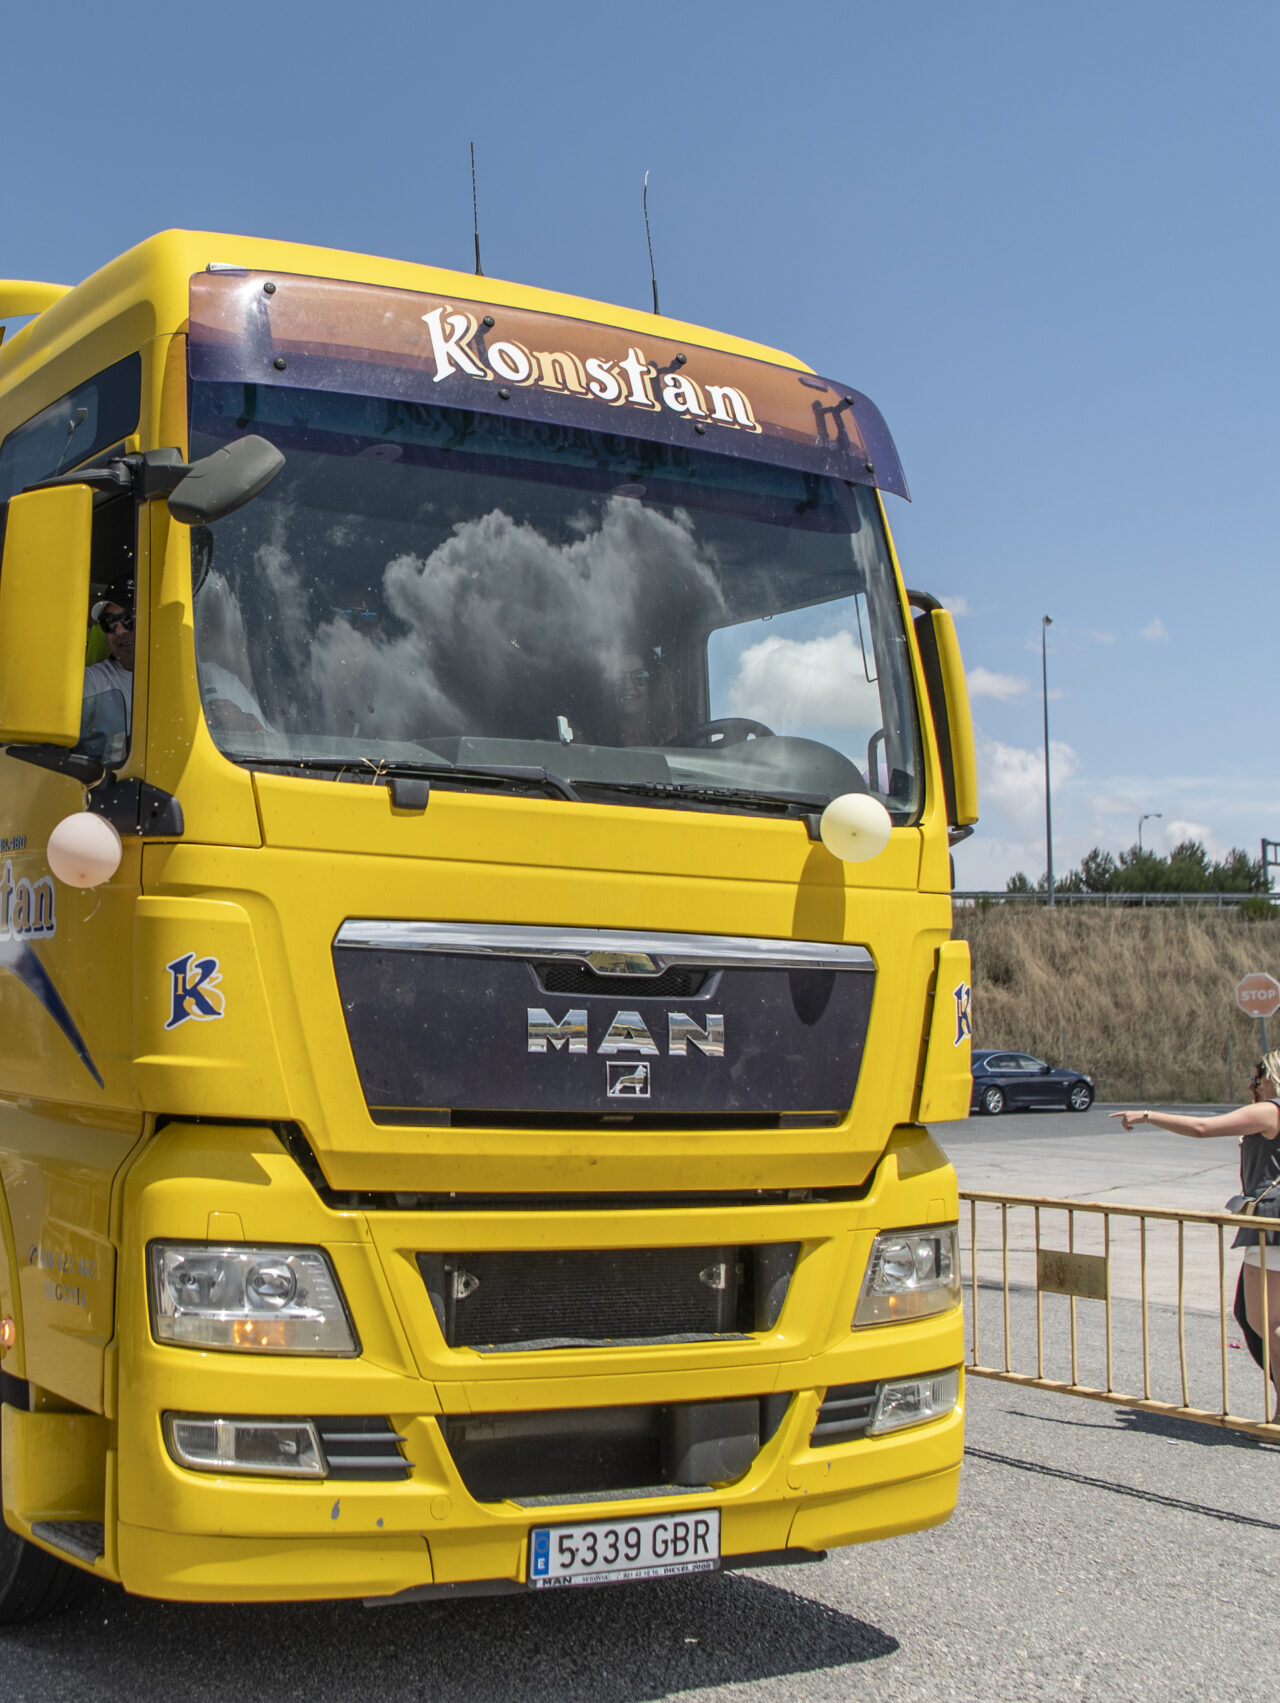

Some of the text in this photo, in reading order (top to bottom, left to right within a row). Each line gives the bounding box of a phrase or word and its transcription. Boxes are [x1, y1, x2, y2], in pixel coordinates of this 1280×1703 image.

[420, 304, 763, 435] Konstan
[1241, 989, 1276, 1001] STOP
[527, 1008, 725, 1057] MAN
[558, 1519, 710, 1568] 5339 GBR
[537, 1557, 546, 1570] E
[542, 1577, 572, 1587] MAN
[664, 1565, 689, 1574] DIESEL
[692, 1562, 711, 1571] 2000
